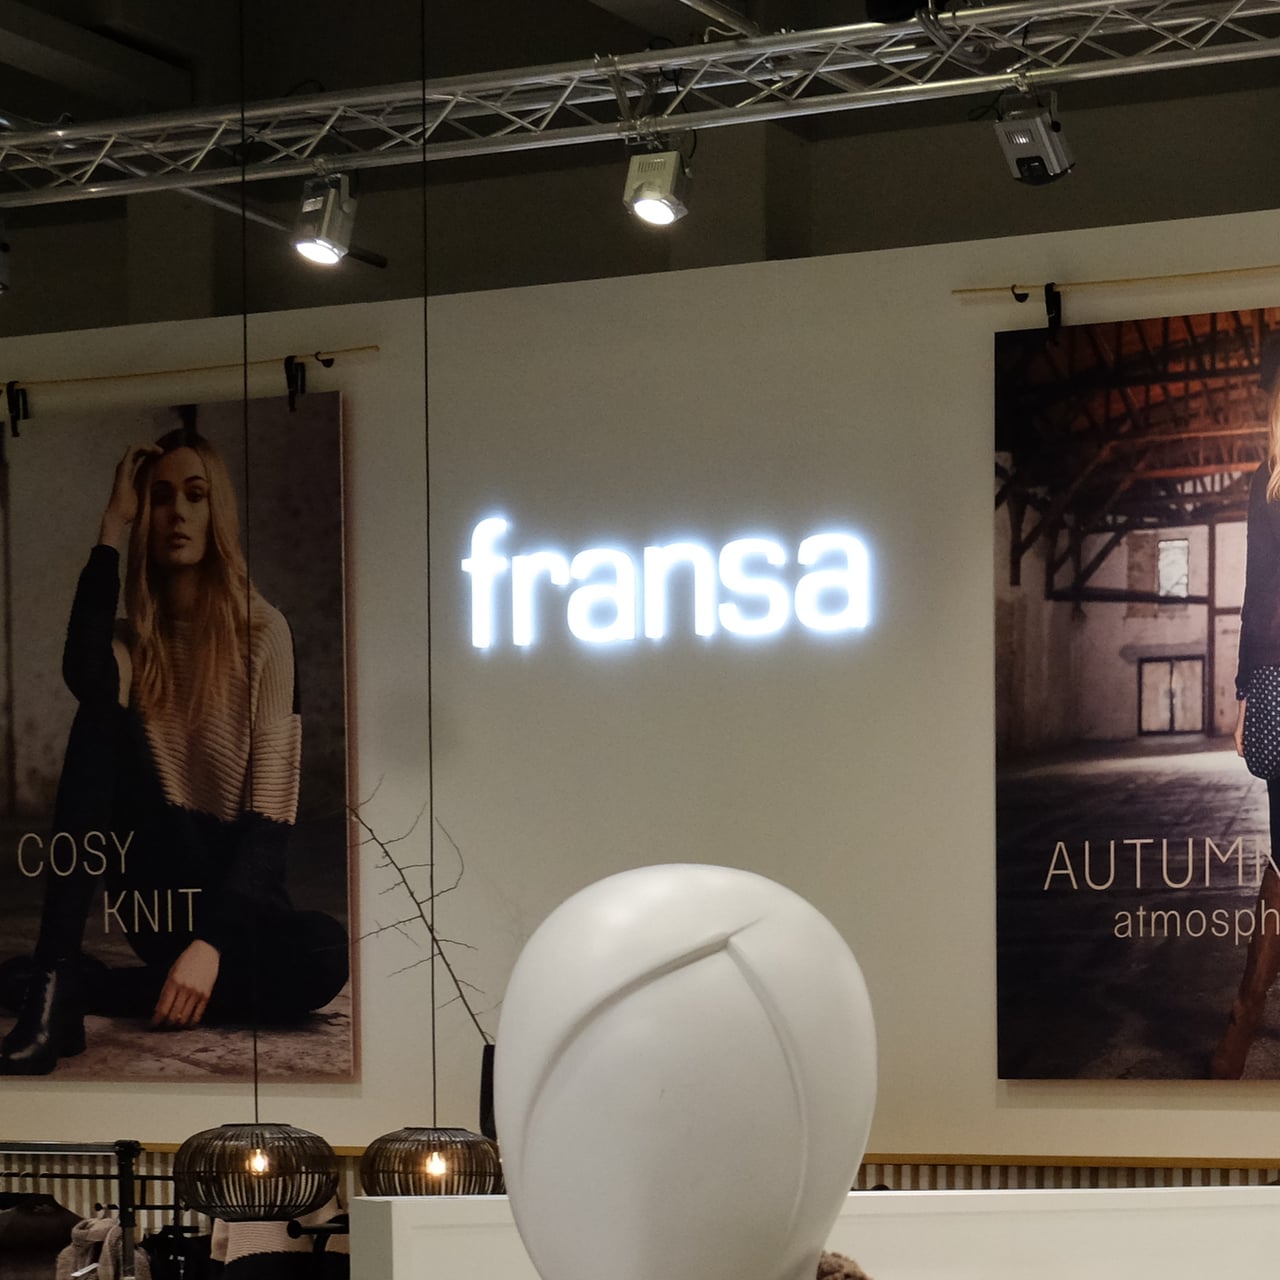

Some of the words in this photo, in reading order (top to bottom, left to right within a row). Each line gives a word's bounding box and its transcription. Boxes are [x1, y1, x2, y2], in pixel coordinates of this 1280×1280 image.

[462, 515, 869, 650] fransa
[17, 831, 135, 878] COSY
[102, 887, 203, 935] KNIT
